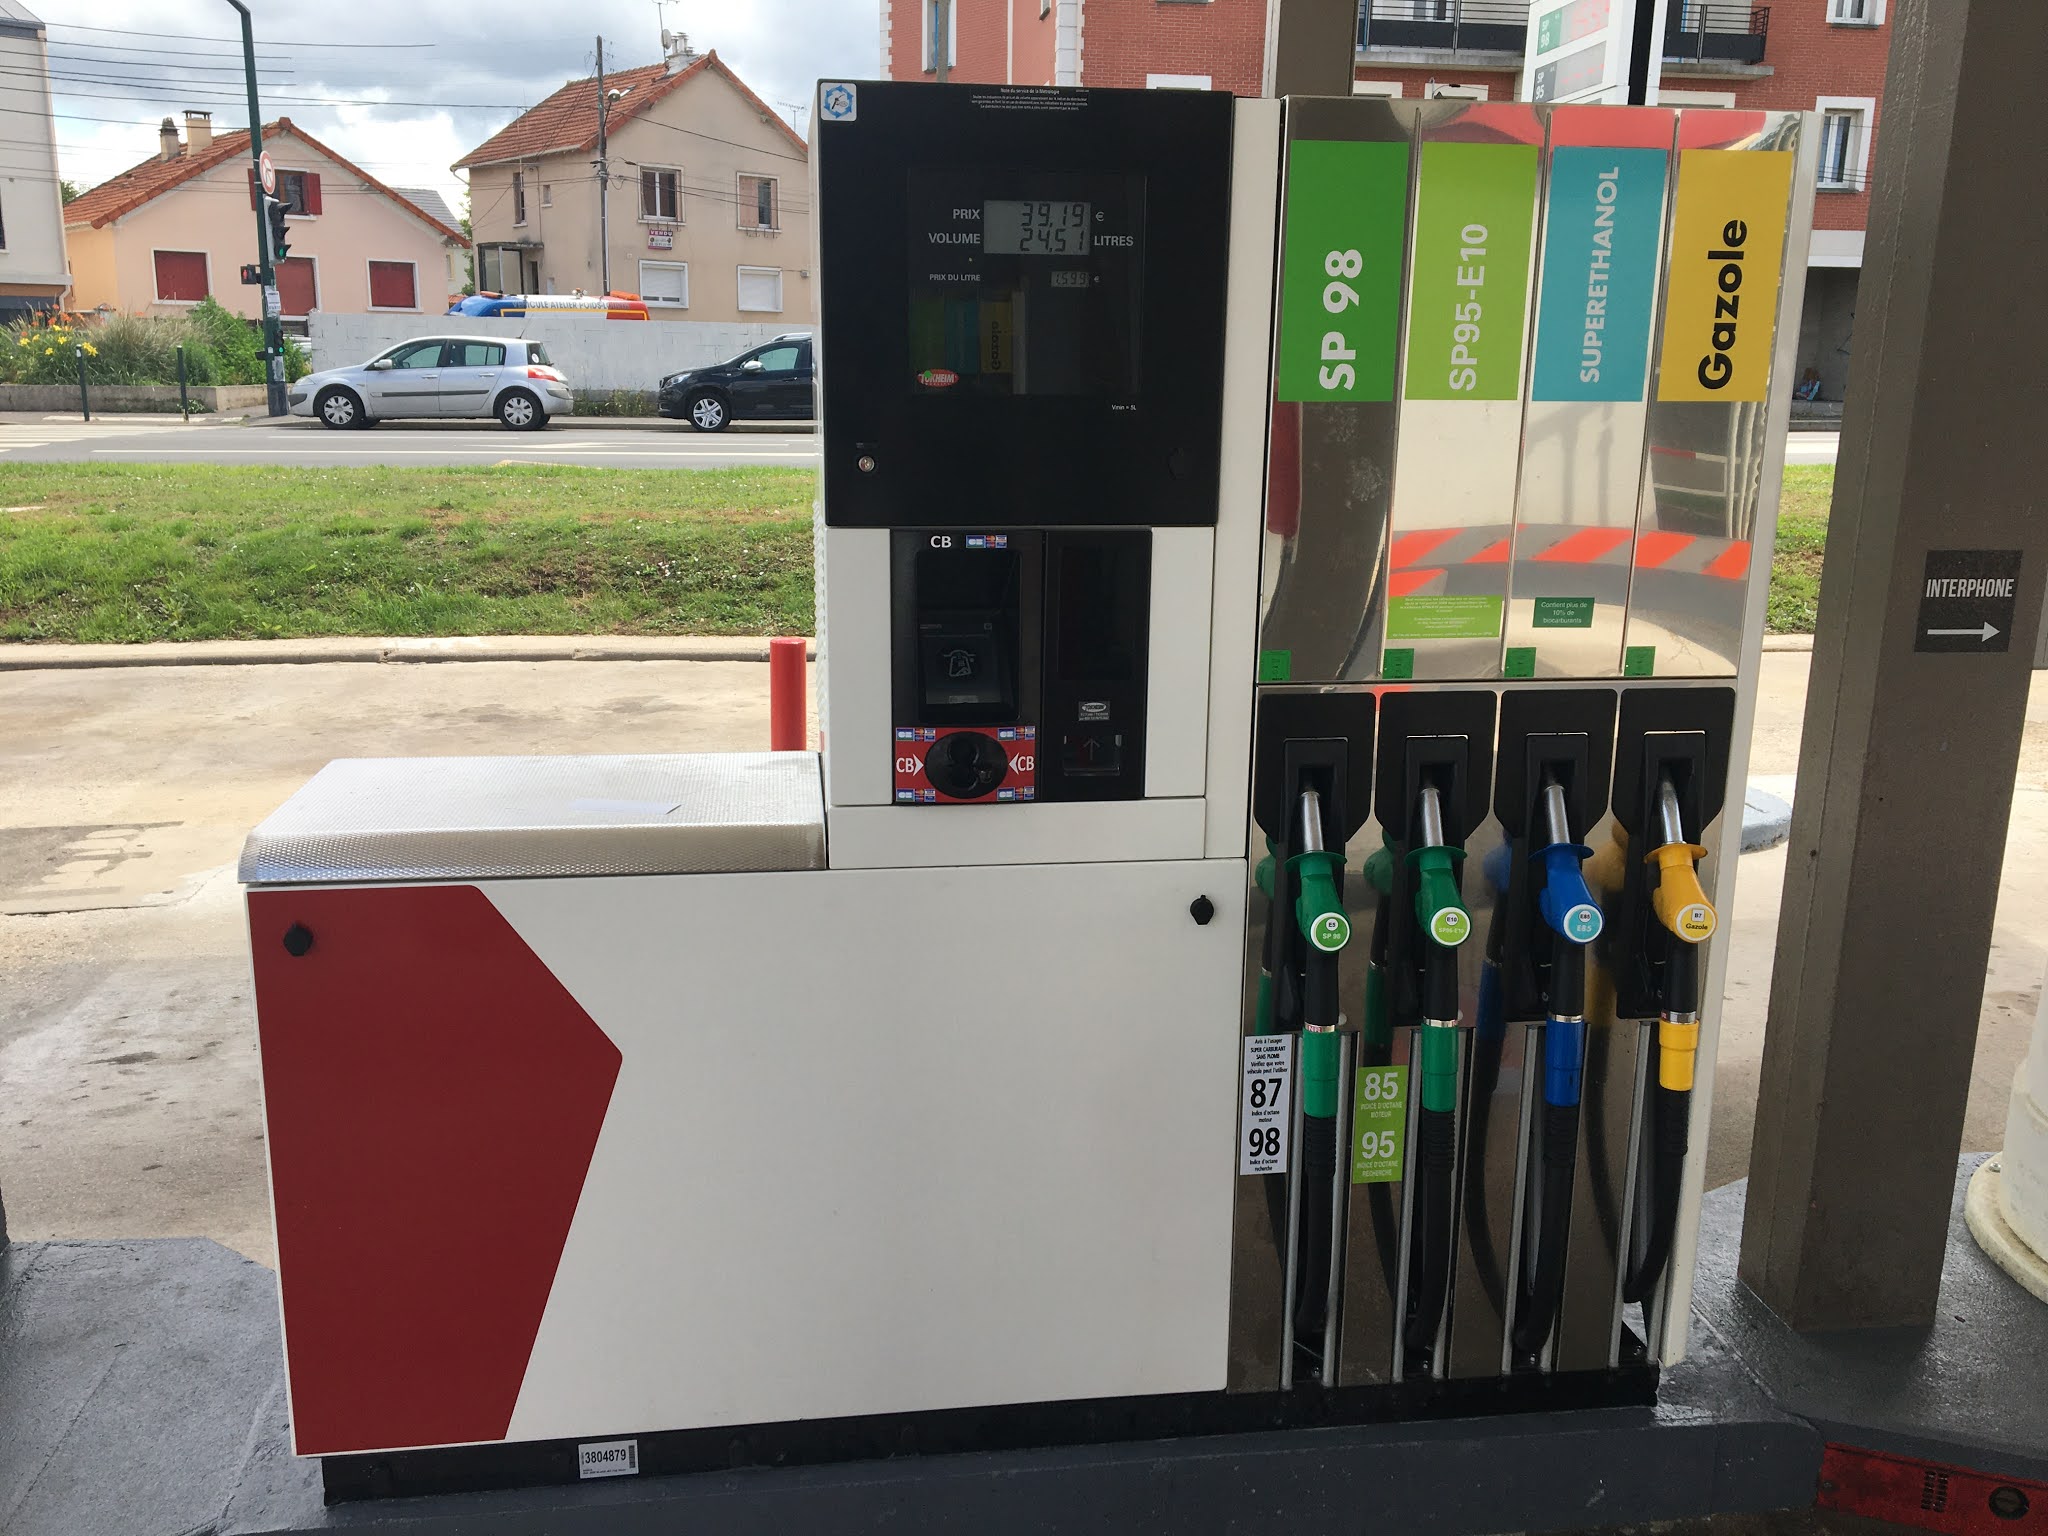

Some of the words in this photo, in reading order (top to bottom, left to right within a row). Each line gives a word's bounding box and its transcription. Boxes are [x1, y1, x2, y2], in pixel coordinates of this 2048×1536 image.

[953, 209, 980, 219] PRIX
[1096, 212, 1104, 221] €
[928, 233, 980, 244] VOLUME
[1094, 235, 1134, 246] LITRES
[1323, 249, 1363, 314] 98
[1580, 167, 1619, 383] SUPERETHANOL
[550, 301, 577, 309] ATELIER
[1449, 224, 1488, 391] SP95-E10
[1698, 220, 1747, 389] Gazole
[1319, 331, 1356, 391] SP
[930, 536, 951, 548] CB
[1926, 579, 2014, 598] INTERPHONE
[896, 758, 914, 773] CB
[1018, 756, 1035, 771] CB
[1250, 1078, 1282, 1108] 87
[1364, 1072, 1398, 1100] 85
[1249, 1127, 1280, 1157] 98
[1362, 1131, 1395, 1159] 95
[1362, 1169, 1392, 1177] RECHERCHE
[585, 1449, 626, 1464] 3804879
